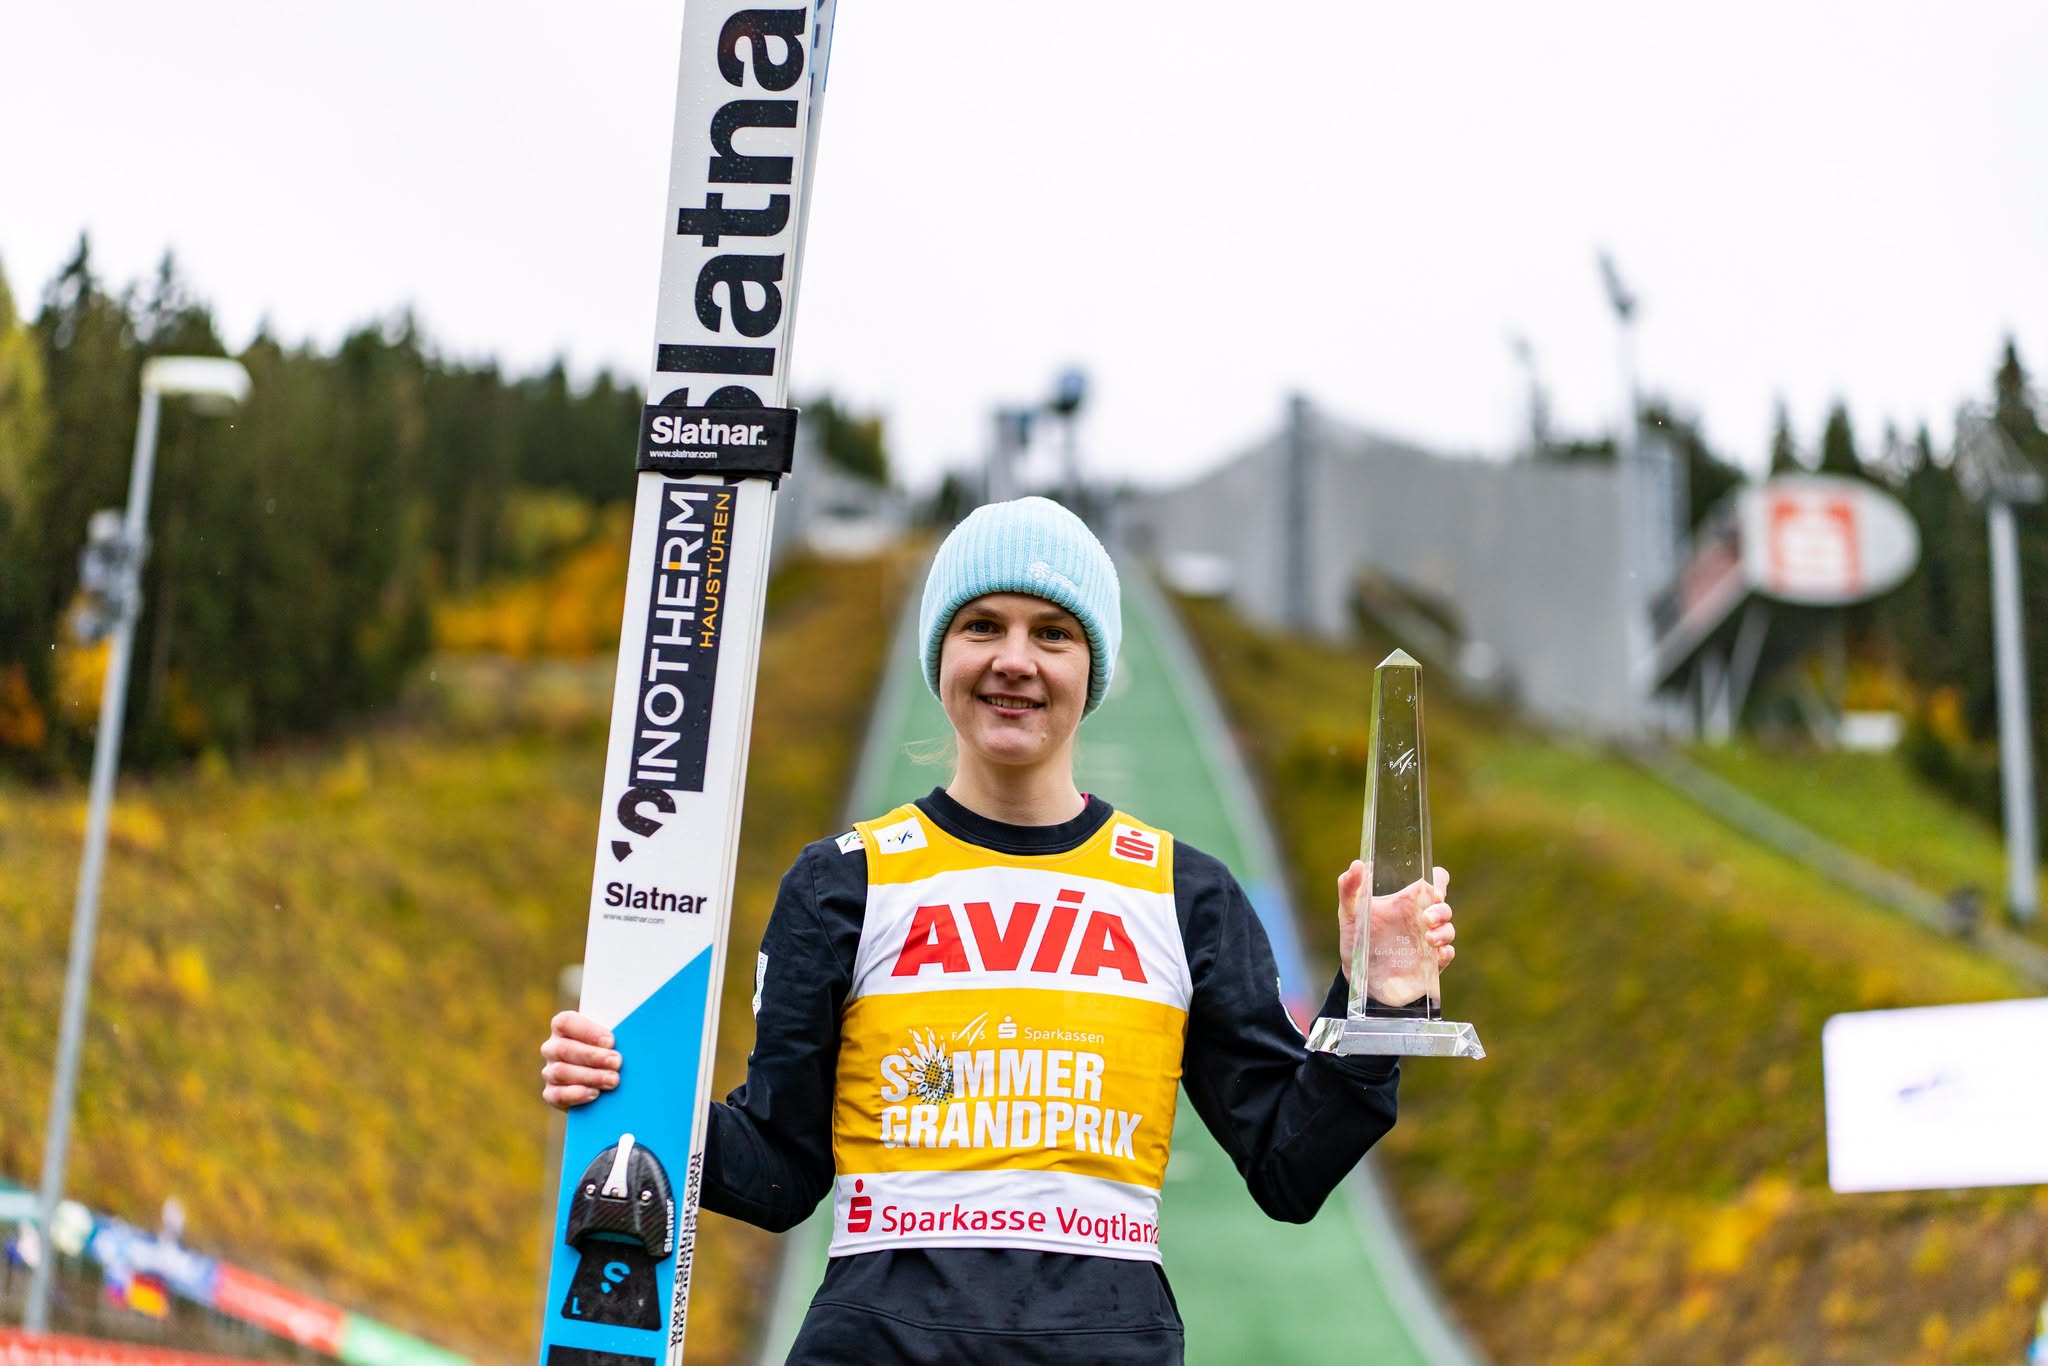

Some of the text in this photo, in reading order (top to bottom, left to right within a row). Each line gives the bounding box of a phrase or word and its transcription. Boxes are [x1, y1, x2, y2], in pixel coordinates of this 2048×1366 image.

[650, 416, 763, 446] Slatnar
[649, 450, 718, 459] www.slatnar.com
[700, 493, 731, 648] HAUSTÜREN
[636, 490, 709, 782] INOTHERM
[604, 881, 708, 914] Slatnar
[1024, 1027, 1105, 1045] Sparkassen
[663, 1198, 675, 1254] Slatnar
[881, 1203, 1047, 1236] Sparkasse
